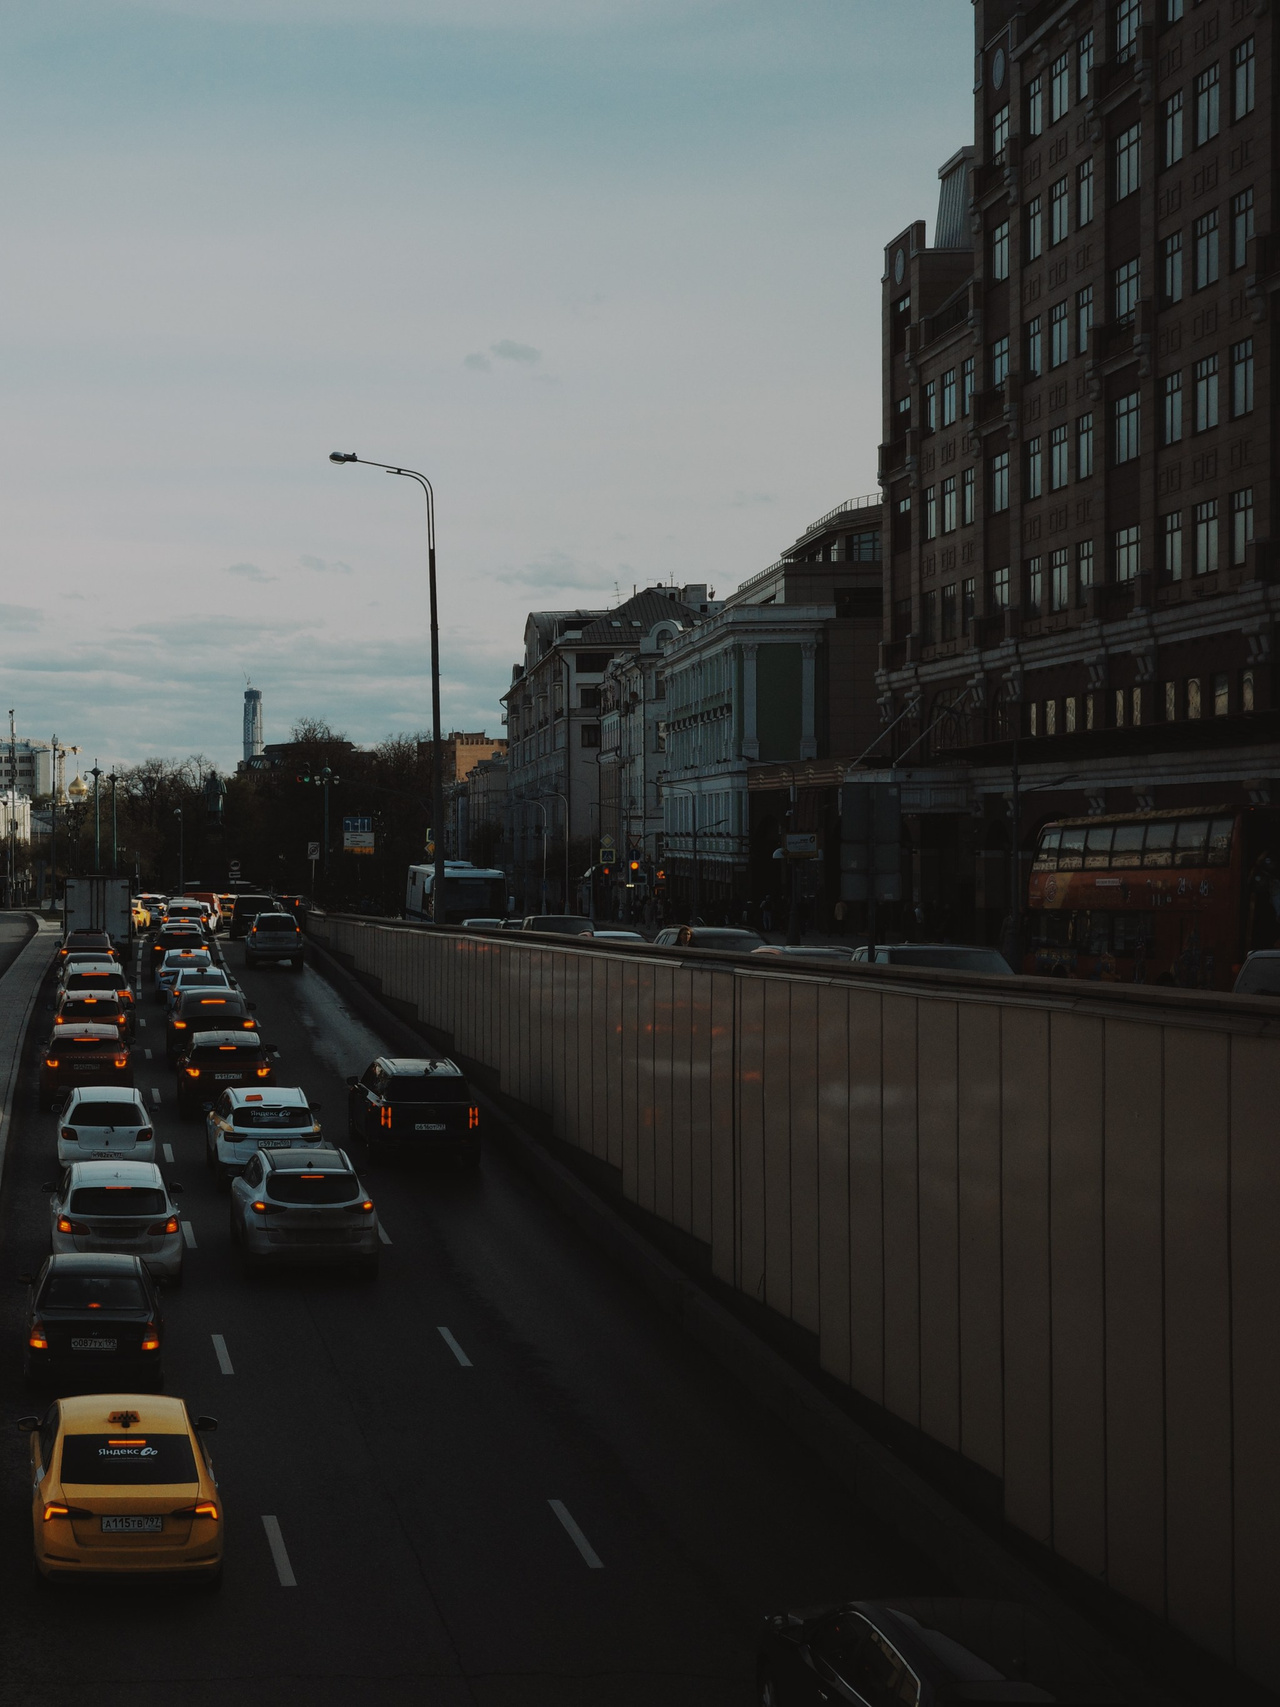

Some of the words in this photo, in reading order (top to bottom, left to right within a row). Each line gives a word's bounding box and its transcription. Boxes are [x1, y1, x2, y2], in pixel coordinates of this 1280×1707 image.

[98, 1448, 140, 1456] Яндекс
[140, 1447, 159, 1456] Go
[105, 1518, 143, 1528] А115ТВ
